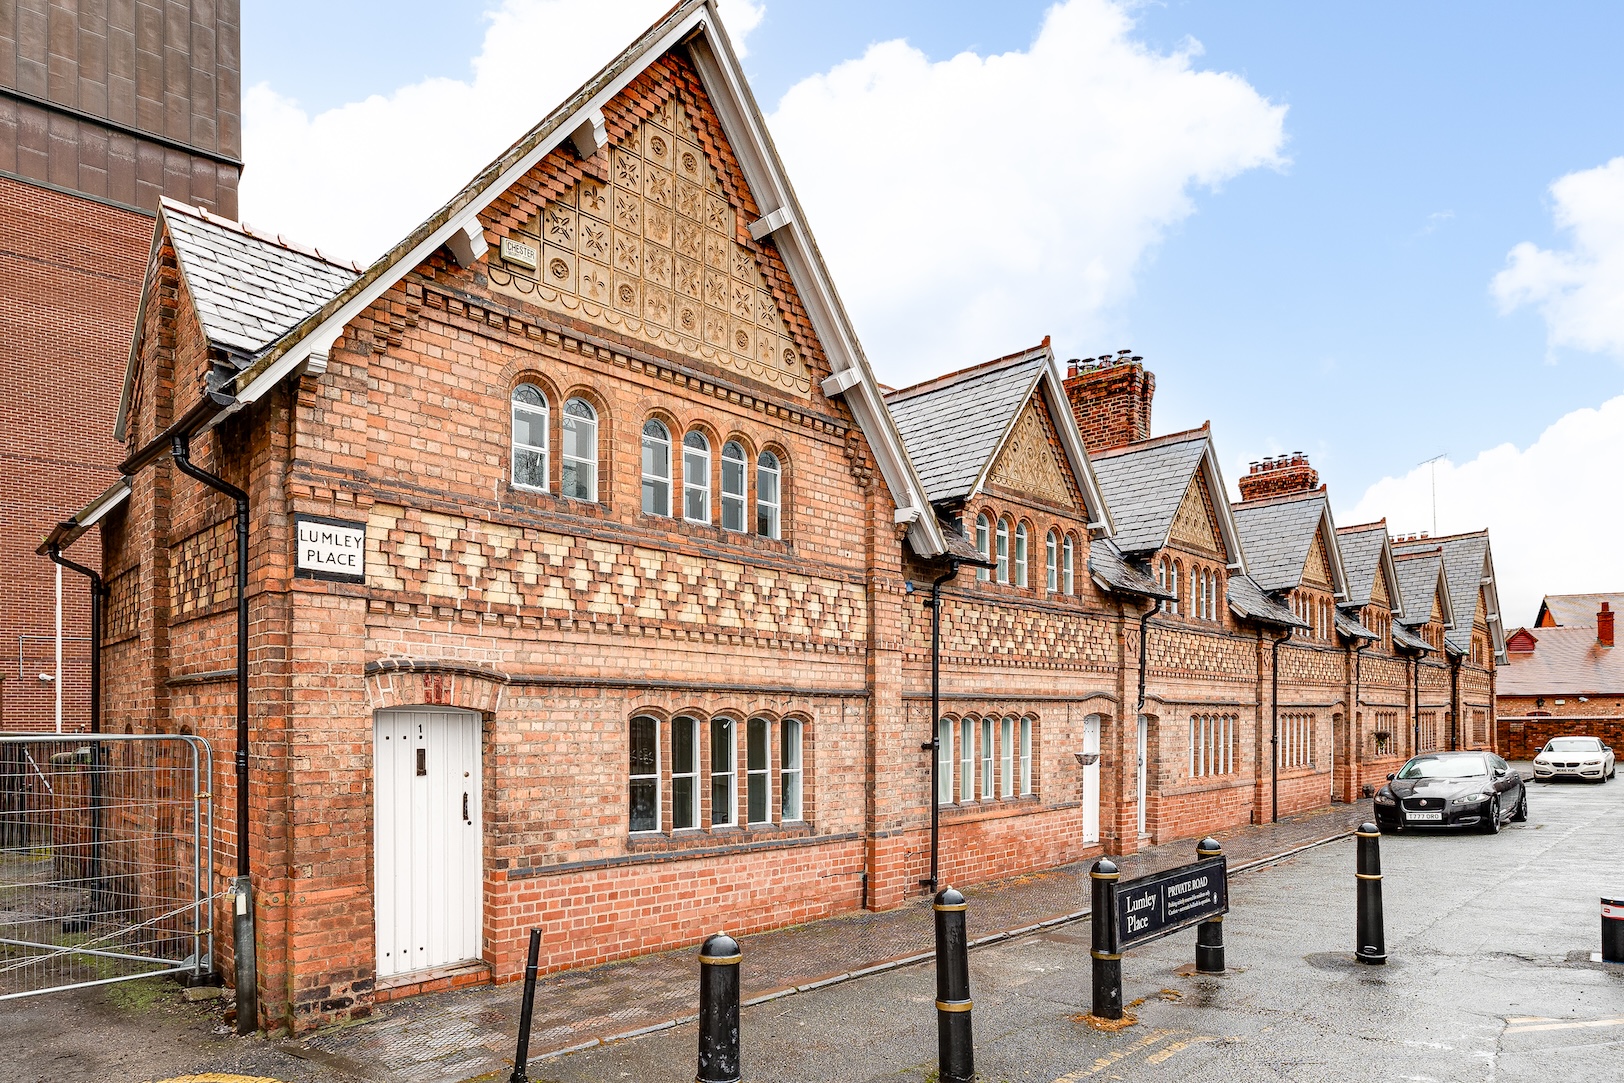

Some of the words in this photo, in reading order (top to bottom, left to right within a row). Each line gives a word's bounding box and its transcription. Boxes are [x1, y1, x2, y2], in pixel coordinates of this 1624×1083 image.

[507, 241, 535, 260] CHESTER
[300, 529, 362, 549] LUMLEY
[307, 549, 356, 567] PLACE
[418, 723, 423, 733] 1
[1167, 880, 1192, 898] PRIVATE
[1192, 876, 1208, 890] ROAD
[1126, 891, 1157, 914] Lumley
[1127, 914, 1149, 933] Place
